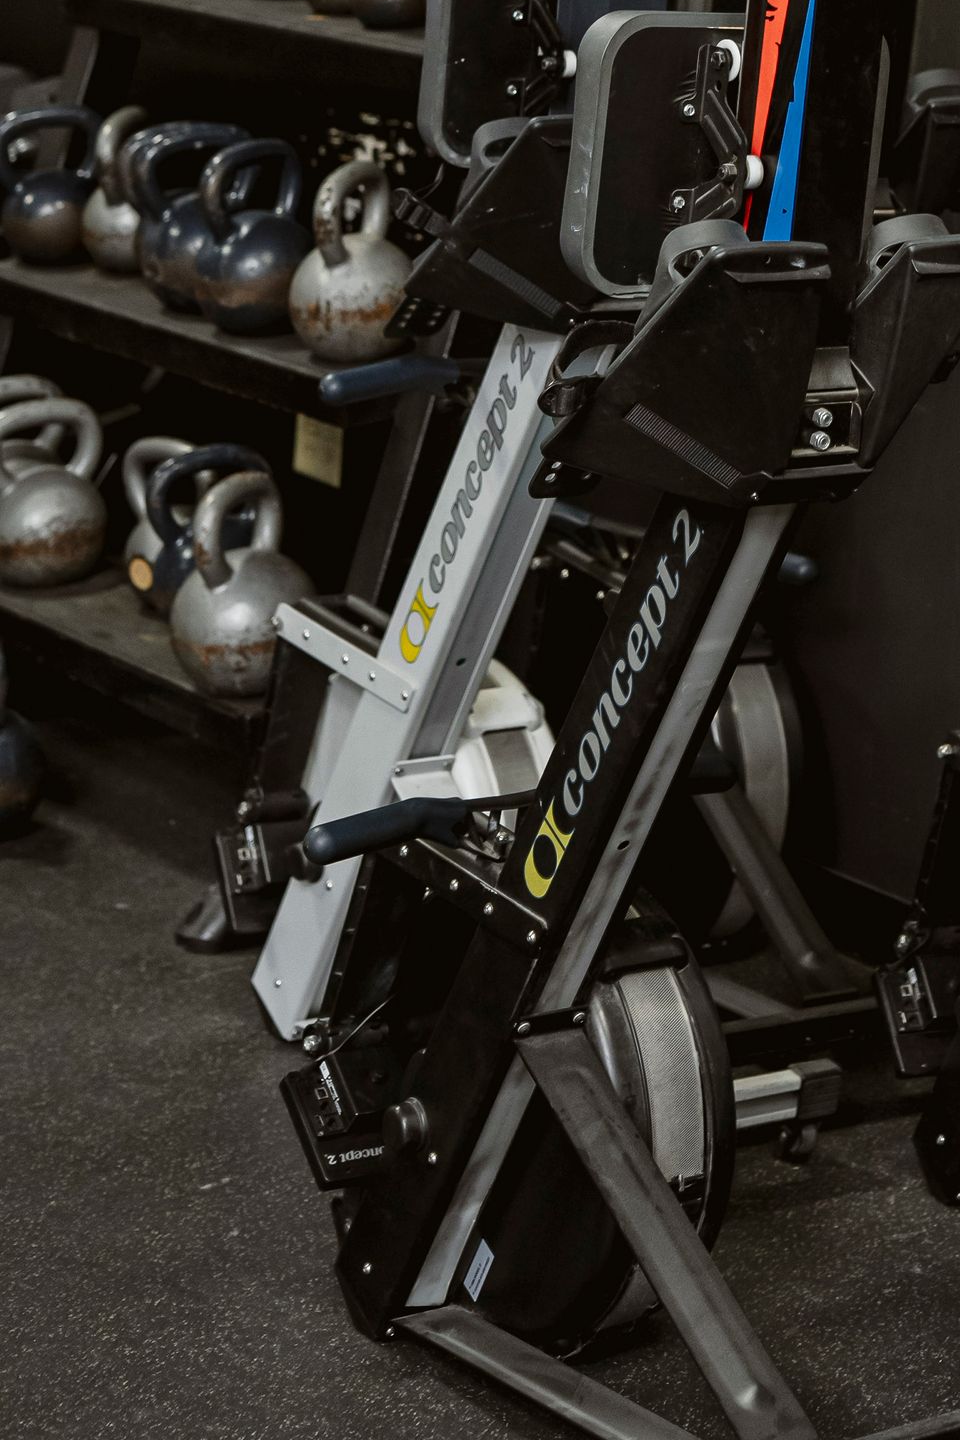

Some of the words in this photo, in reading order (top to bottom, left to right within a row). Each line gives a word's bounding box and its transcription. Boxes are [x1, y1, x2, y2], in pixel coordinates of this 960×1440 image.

[429, 373, 517, 594] concept
[510, 334, 535, 381] 2
[563, 555, 680, 816] concept
[671, 508, 701, 566] 2
